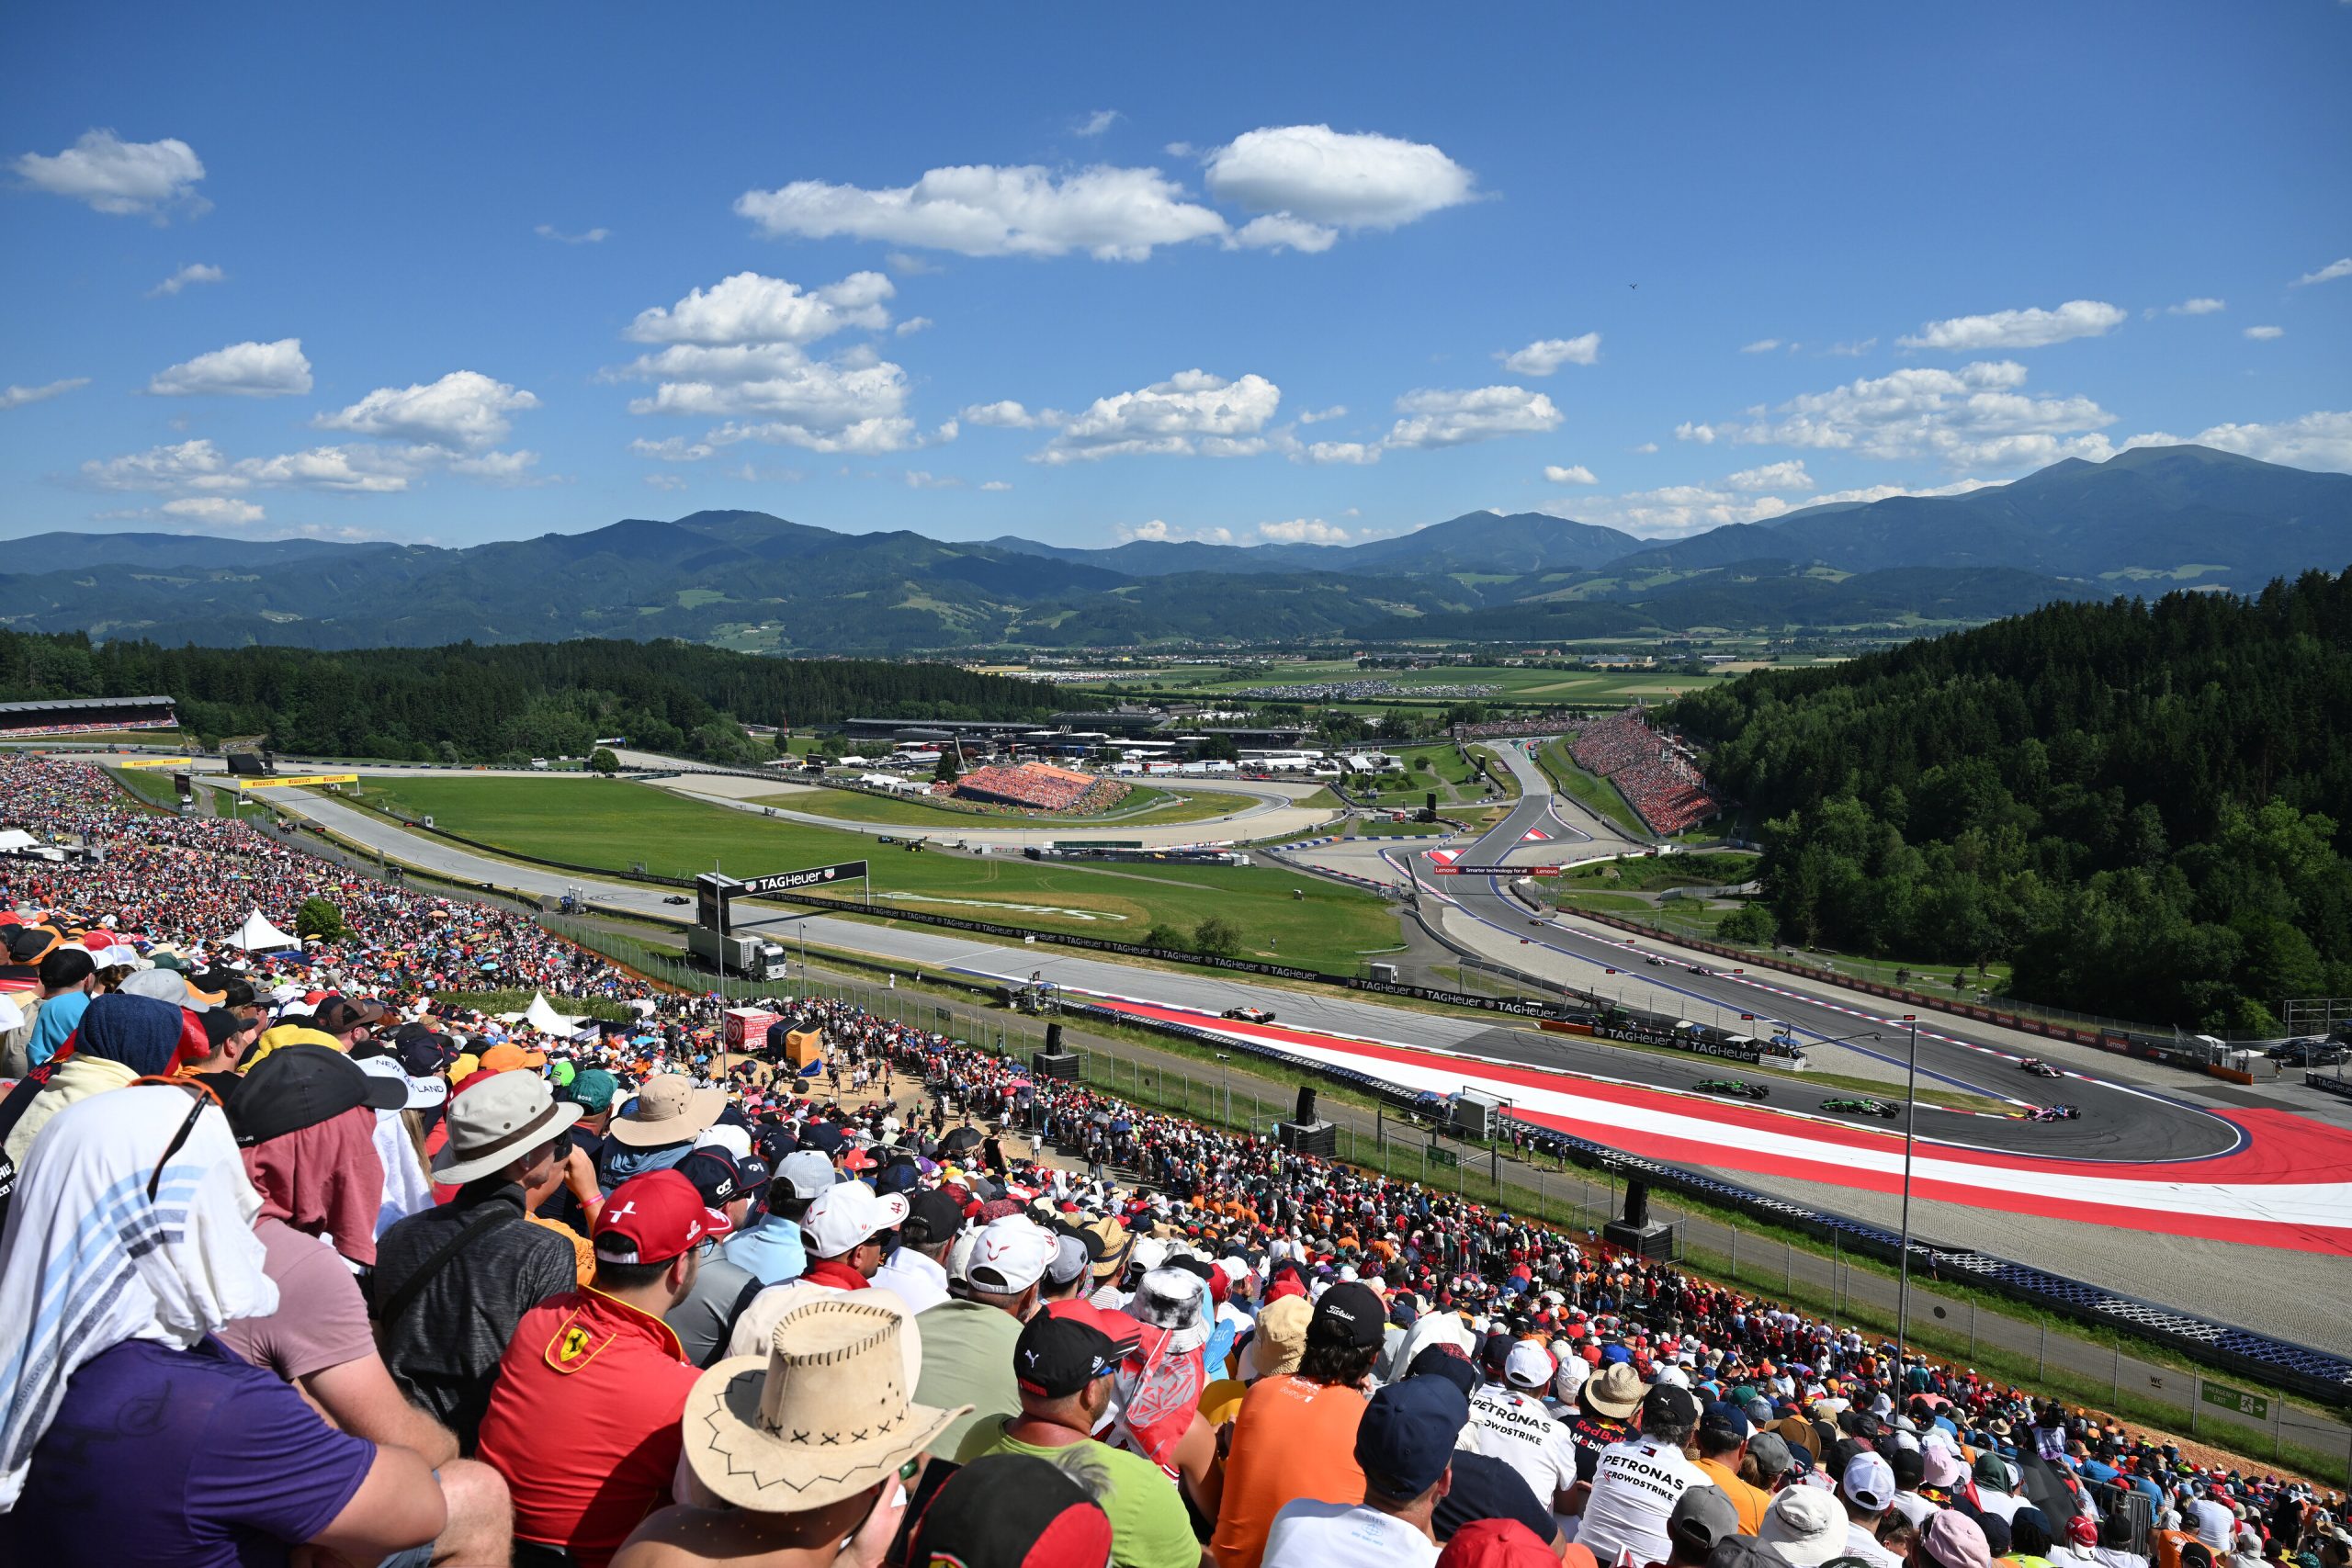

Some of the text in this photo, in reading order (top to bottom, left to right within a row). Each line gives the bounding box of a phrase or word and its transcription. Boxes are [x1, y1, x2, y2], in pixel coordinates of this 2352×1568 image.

[760, 872, 821, 889] TAGHeuer
[944, 919, 974, 930] TAGHeuer
[982, 924, 1013, 936] TAGHeuer
[1067, 936, 1102, 948] TAGHeuer
[1113, 942, 1151, 956] TAGHeuer
[1162, 950, 1202, 964] TAGHeuer
[1215, 957, 1259, 971] TAGHeuer
[1272, 966, 1317, 981] TAGHeuer
[1361, 980, 1410, 996] TAGHeuer
[1427, 990, 1482, 1007] TAGHeuer
[1498, 1001, 1557, 1018] TAGHeuer
[1951, 1004, 1966, 1013] Lenovo
[1973, 1010, 1989, 1019] Lenovo
[1997, 1015, 2014, 1024] Lenovo
[2022, 1021, 2040, 1031] Lenovo
[1608, 1029, 1672, 1046] TAGHeuer
[2049, 1026, 2067, 1037] Lenovo
[2076, 1032, 2096, 1043] Lenovo
[1690, 1041, 1758, 1061] TAGHeuer
[2106, 1039, 2126, 1050] Lenovo
[376, 1059, 401, 1073] NEW
[890, 1201, 904, 1214] 44
[1044, 1235, 1056, 1248] 44
[1326, 1304, 1356, 1322] Titleist
[2150, 1375, 2162, 1386] WC
[2204, 1385, 2237, 1400] EMERGENCY
[2213, 1394, 2227, 1404] EXIT
[1472, 1399, 1552, 1434] PETRONAS
[1484, 1419, 1543, 1446] OWDSTRIKE
[1576, 1419, 1601, 1437] Red
[1571, 1432, 1605, 1453] Mobil
[1603, 1455, 1684, 1491] PETRONAS
[1608, 1471, 1675, 1502] CROWDSTRIKE
